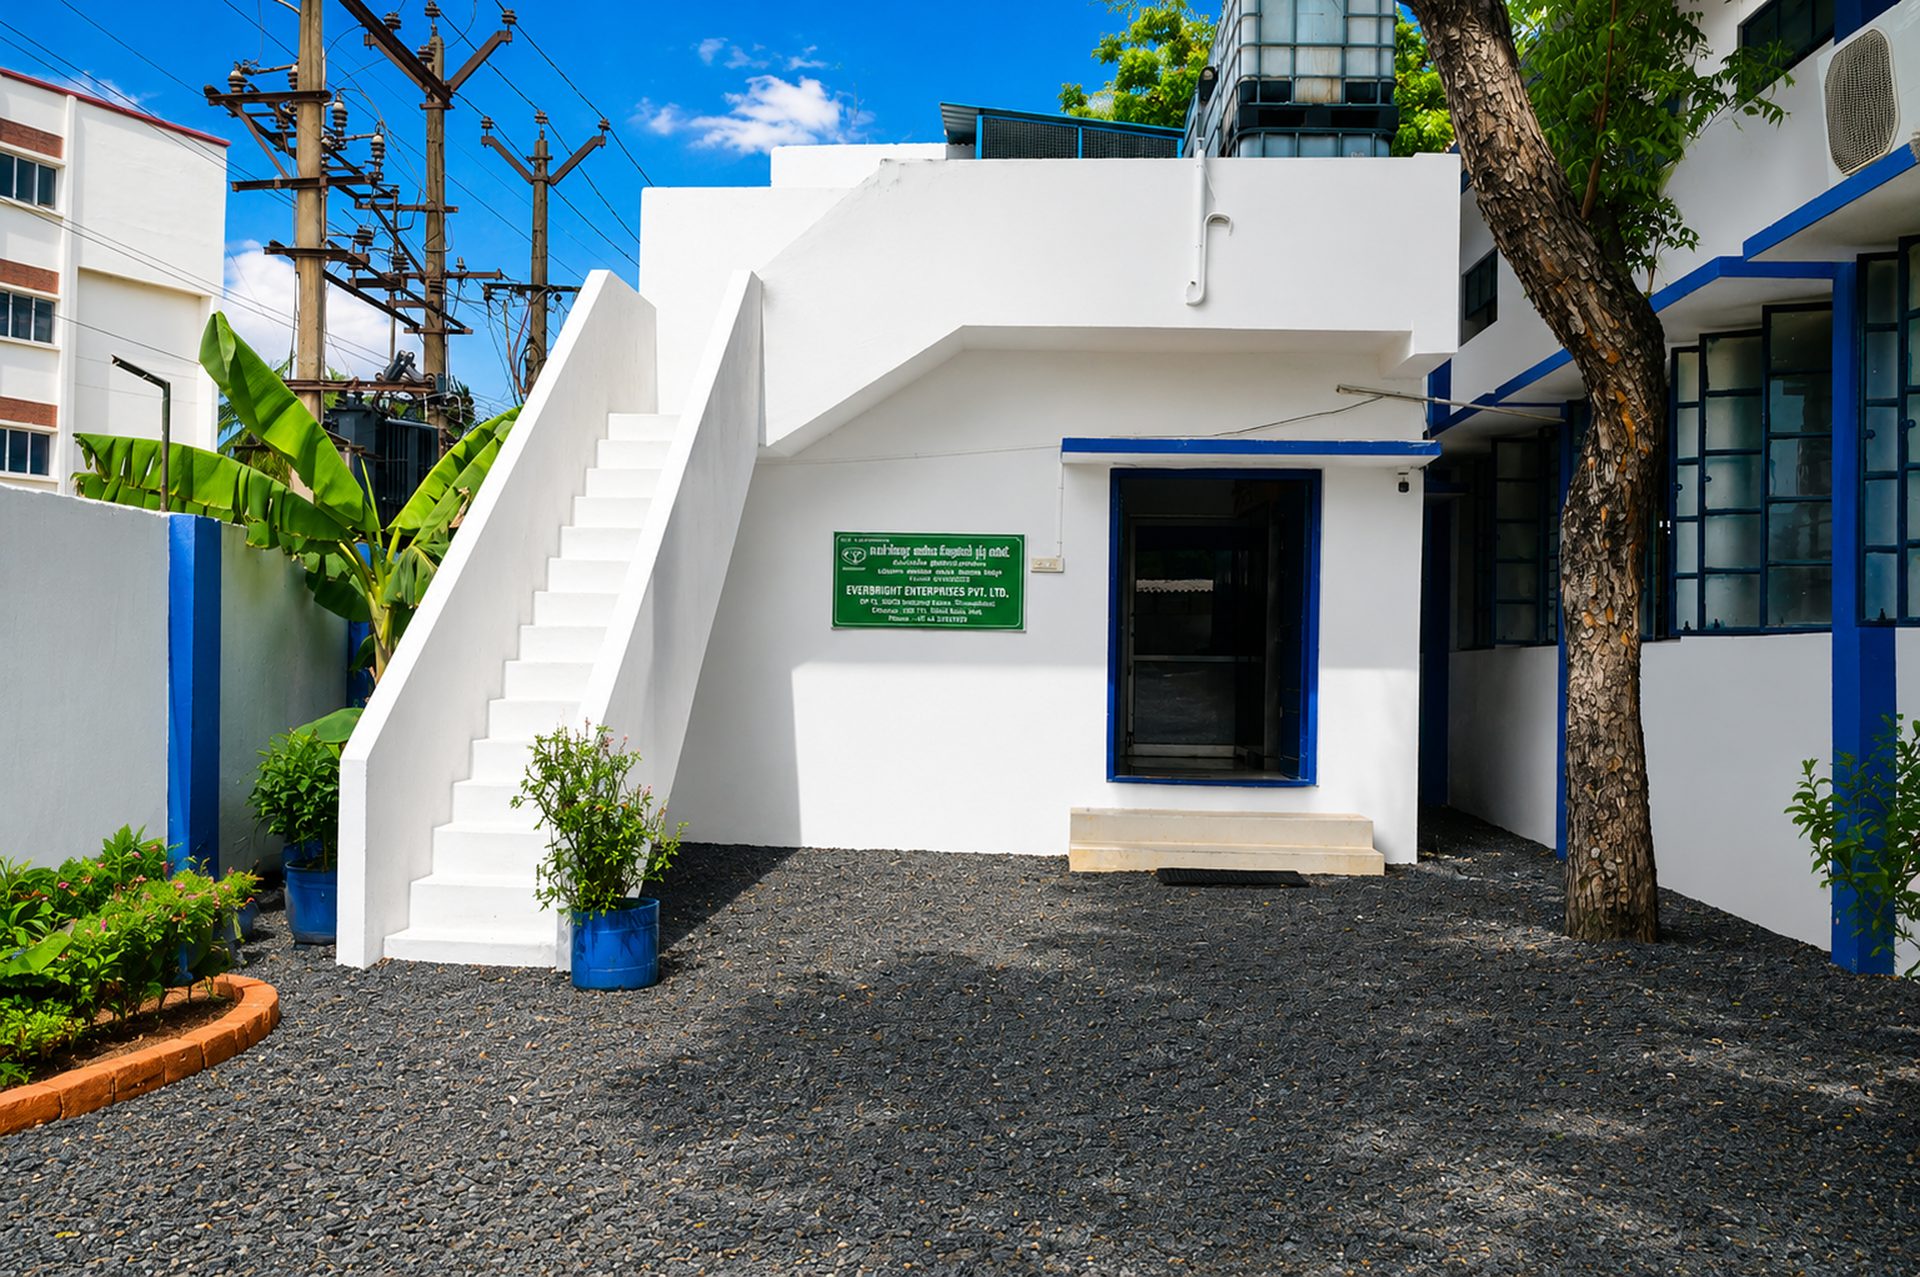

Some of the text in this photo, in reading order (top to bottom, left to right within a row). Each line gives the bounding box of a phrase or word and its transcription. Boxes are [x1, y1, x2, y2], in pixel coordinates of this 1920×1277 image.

[846, 585, 1010, 599] EVERBRIGHT ENTERPRISES PVT. LTD.
